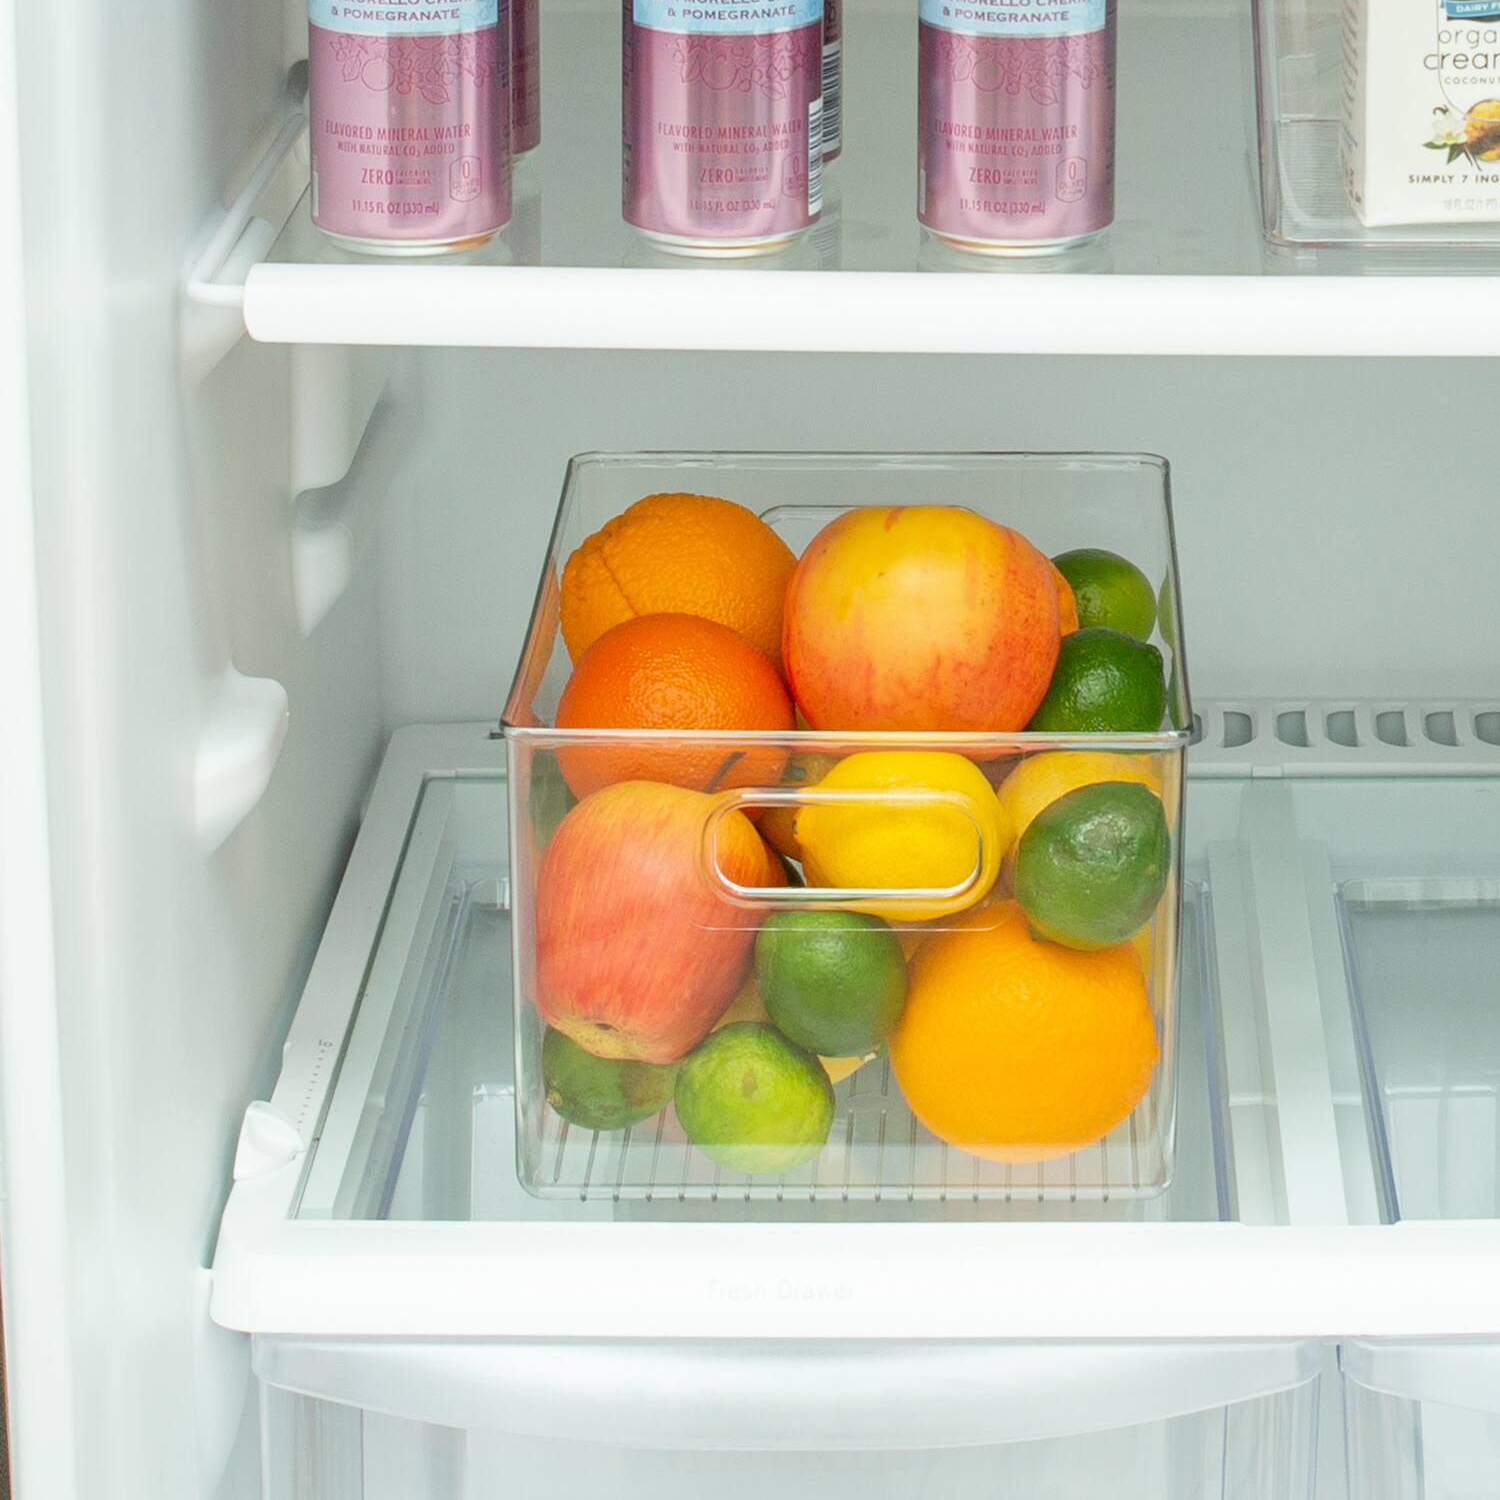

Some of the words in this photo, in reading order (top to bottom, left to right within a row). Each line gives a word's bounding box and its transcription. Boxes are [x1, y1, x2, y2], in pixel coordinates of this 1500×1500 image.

[343, 8, 460, 22] POMEGRANATE
[682, 4, 797, 21] POMEGRANATE
[954, 9, 1070, 23] POMEGRANATE
[1456, 2, 1490, 14] DAIRY
[325, 120, 373, 140] FLAVORED
[376, 125, 430, 142] MINERAL
[433, 123, 471, 141] WATER
[657, 121, 713, 140] FLAVORED
[716, 125, 768, 140] MINERAL
[934, 120, 982, 140] FLAVORED
[985, 125, 1038, 142] MINERAL
[1041, 124, 1079, 140] WATER
[361, 167, 394, 186] ZERO
[700, 167, 734, 184] ZERO
[969, 167, 1001, 185] ZERO
[1408, 174, 1455, 184] SIMPLY
[706, 1277, 767, 1302] Fresh
[777, 1277, 855, 1301] Drawer
